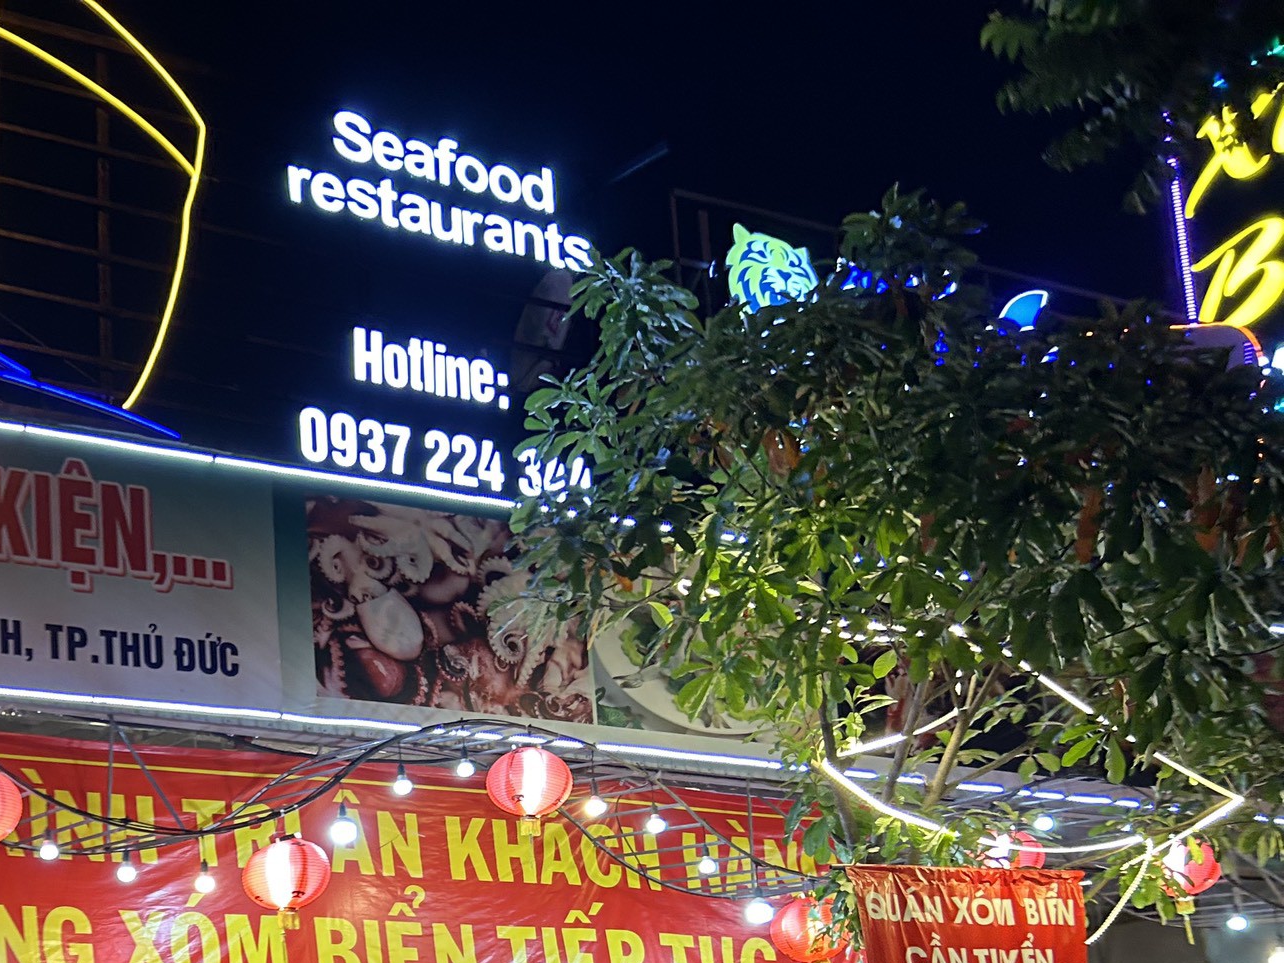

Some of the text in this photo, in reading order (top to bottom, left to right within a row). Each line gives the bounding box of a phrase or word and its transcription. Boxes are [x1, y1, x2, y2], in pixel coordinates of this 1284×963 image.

[332, 109, 557, 215] Seafood
[287, 164, 594, 272] restaurants
[352, 326, 511, 411] Hotline:
[299, 406, 412, 477] 0937
[423, 428, 506, 493] 224
[174, 631, 241, 678] ĐỨC
[330, 788, 424, 879] ÂN
[444, 810, 663, 892] KHÁCH
[865, 886, 945, 925] QUÁN
